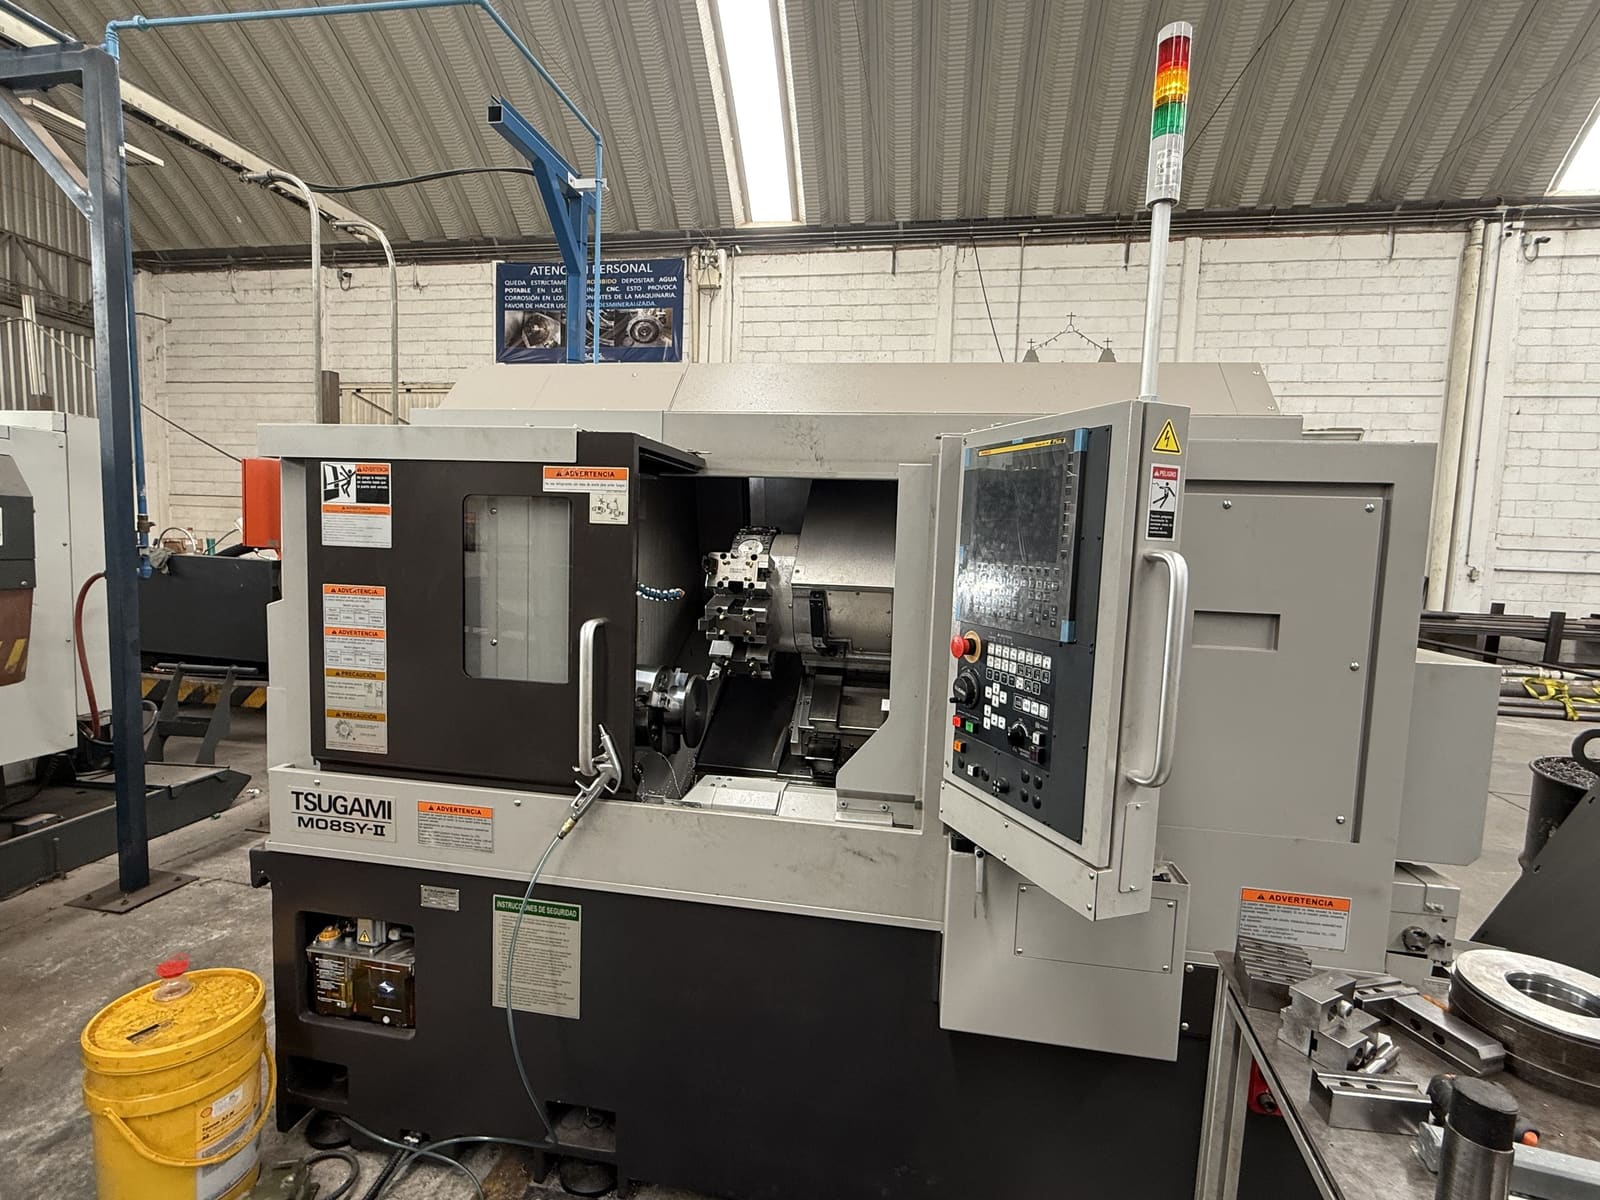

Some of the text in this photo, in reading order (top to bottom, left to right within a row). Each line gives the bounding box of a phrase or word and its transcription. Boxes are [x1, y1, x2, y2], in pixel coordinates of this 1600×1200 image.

[564, 470, 615, 478] ADVERTENCIA
[338, 629, 378, 637] ADVERTENCIA
[291, 790, 392, 820] TSUGAMI
[436, 805, 482, 815] ADVERTENCIA
[1268, 894, 1334, 907] ADVERTENCIA
[496, 900, 538, 913] INSTRUCCNES
